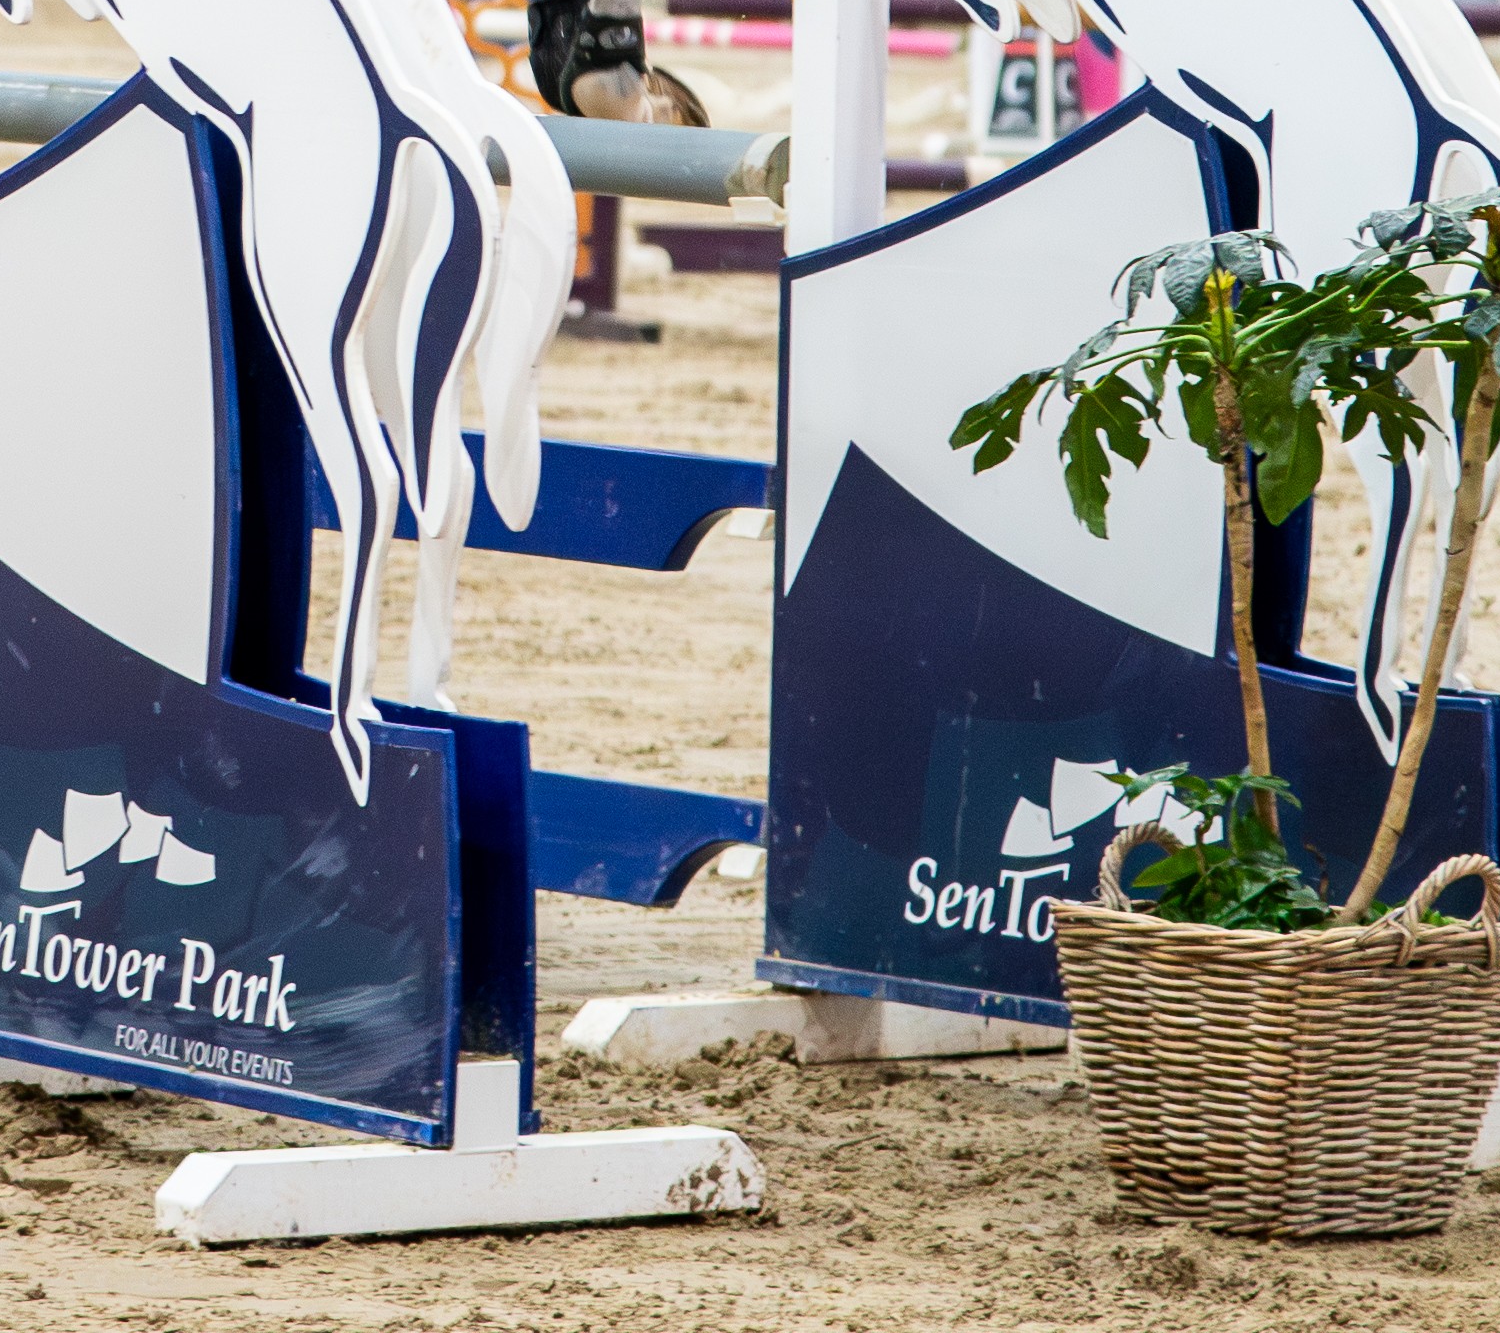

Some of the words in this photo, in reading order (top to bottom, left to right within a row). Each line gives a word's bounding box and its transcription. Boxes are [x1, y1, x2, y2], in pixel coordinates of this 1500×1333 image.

[902, 856, 1070, 943] SenTo
[178, 938, 299, 1035] Park
[114, 1023, 151, 1055] FOR
[150, 1030, 180, 1063] ALL
[182, 1038, 230, 1074] YOUR
[230, 1048, 295, 1088] EVENTS
